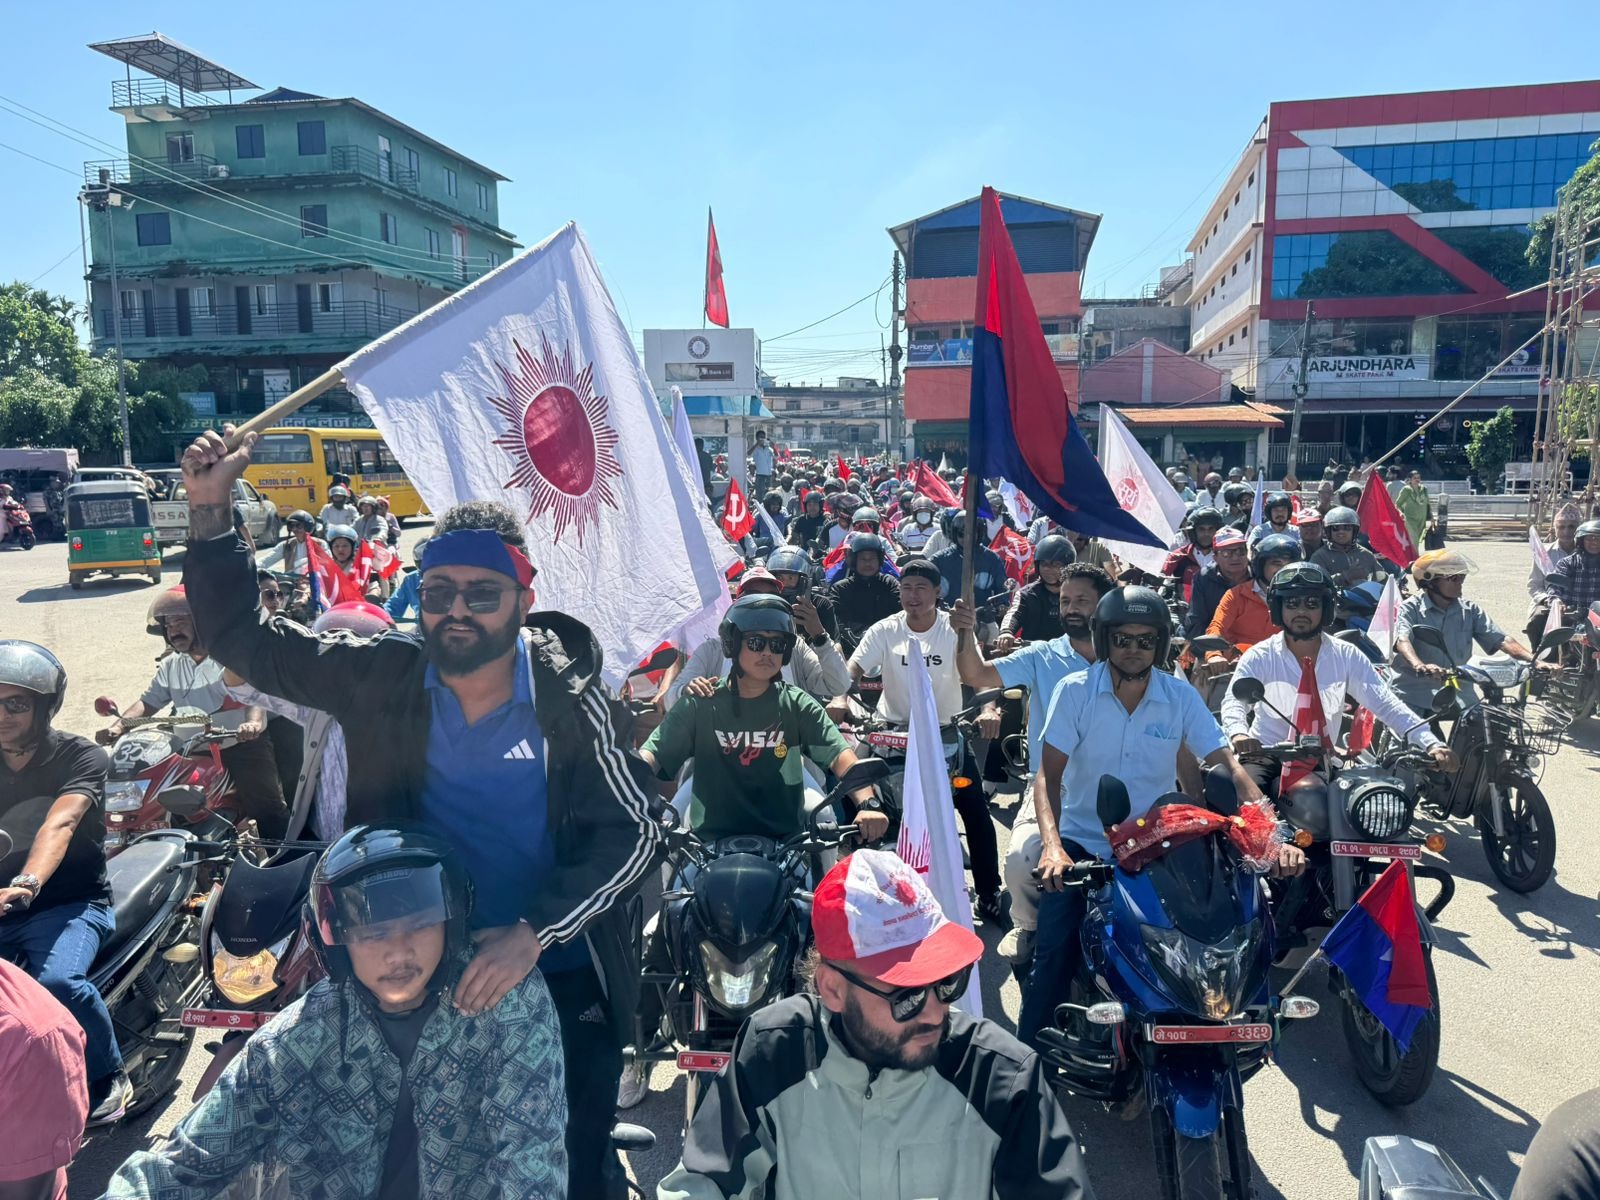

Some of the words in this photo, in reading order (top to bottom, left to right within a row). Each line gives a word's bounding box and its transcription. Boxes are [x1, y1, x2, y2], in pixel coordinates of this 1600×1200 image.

[1309, 358, 1416, 373] ARJUNDHARA
[258, 478, 278, 486] SCHOOL
[901, 654, 943, 667] LT'S
